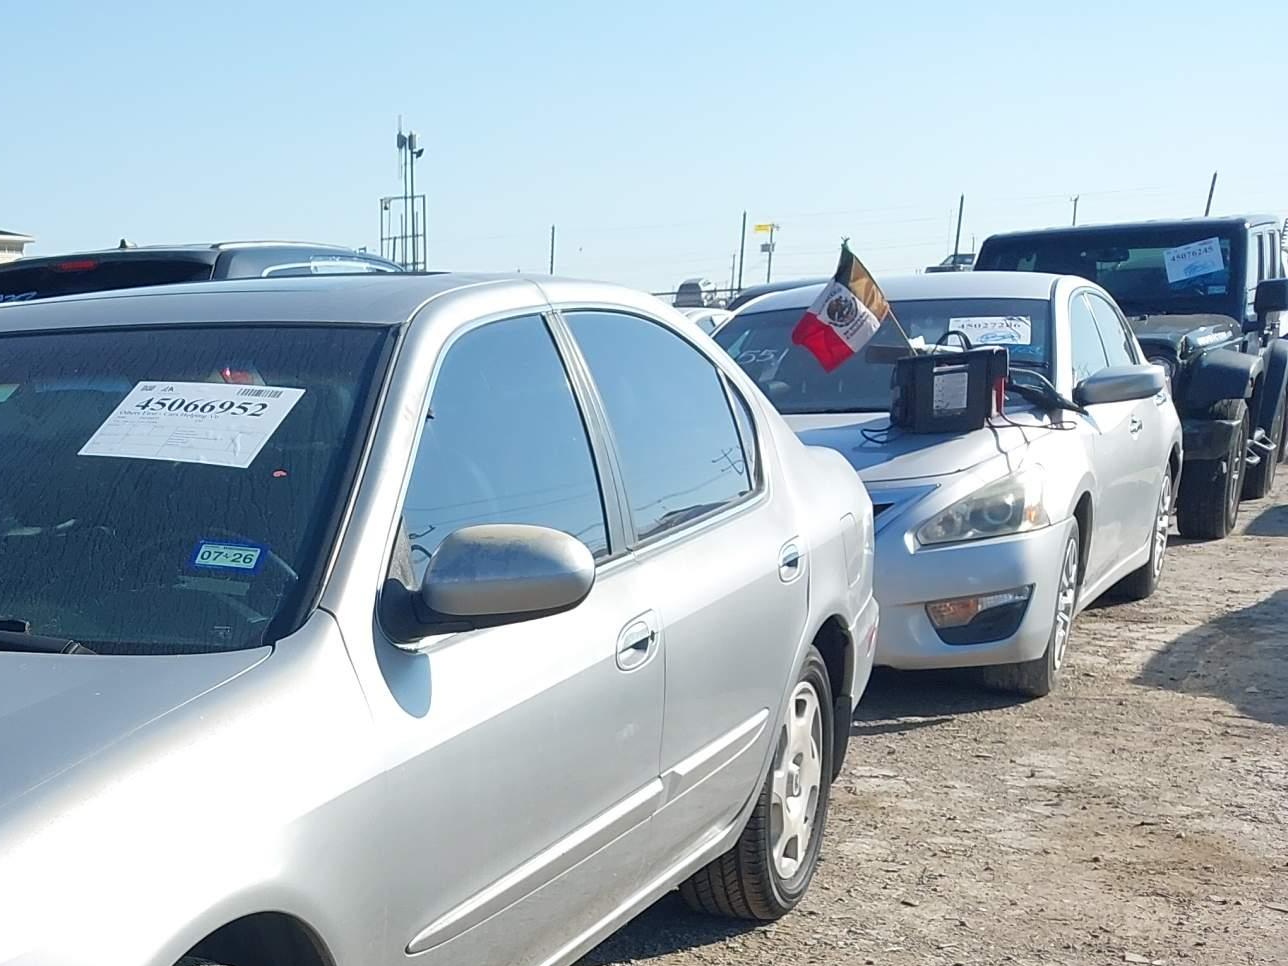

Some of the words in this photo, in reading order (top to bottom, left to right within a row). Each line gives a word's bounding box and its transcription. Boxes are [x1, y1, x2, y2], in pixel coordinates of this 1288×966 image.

[136, 397, 269, 418] 45066952
[200, 550, 224, 561] 07
[230, 552, 255, 564] 26
